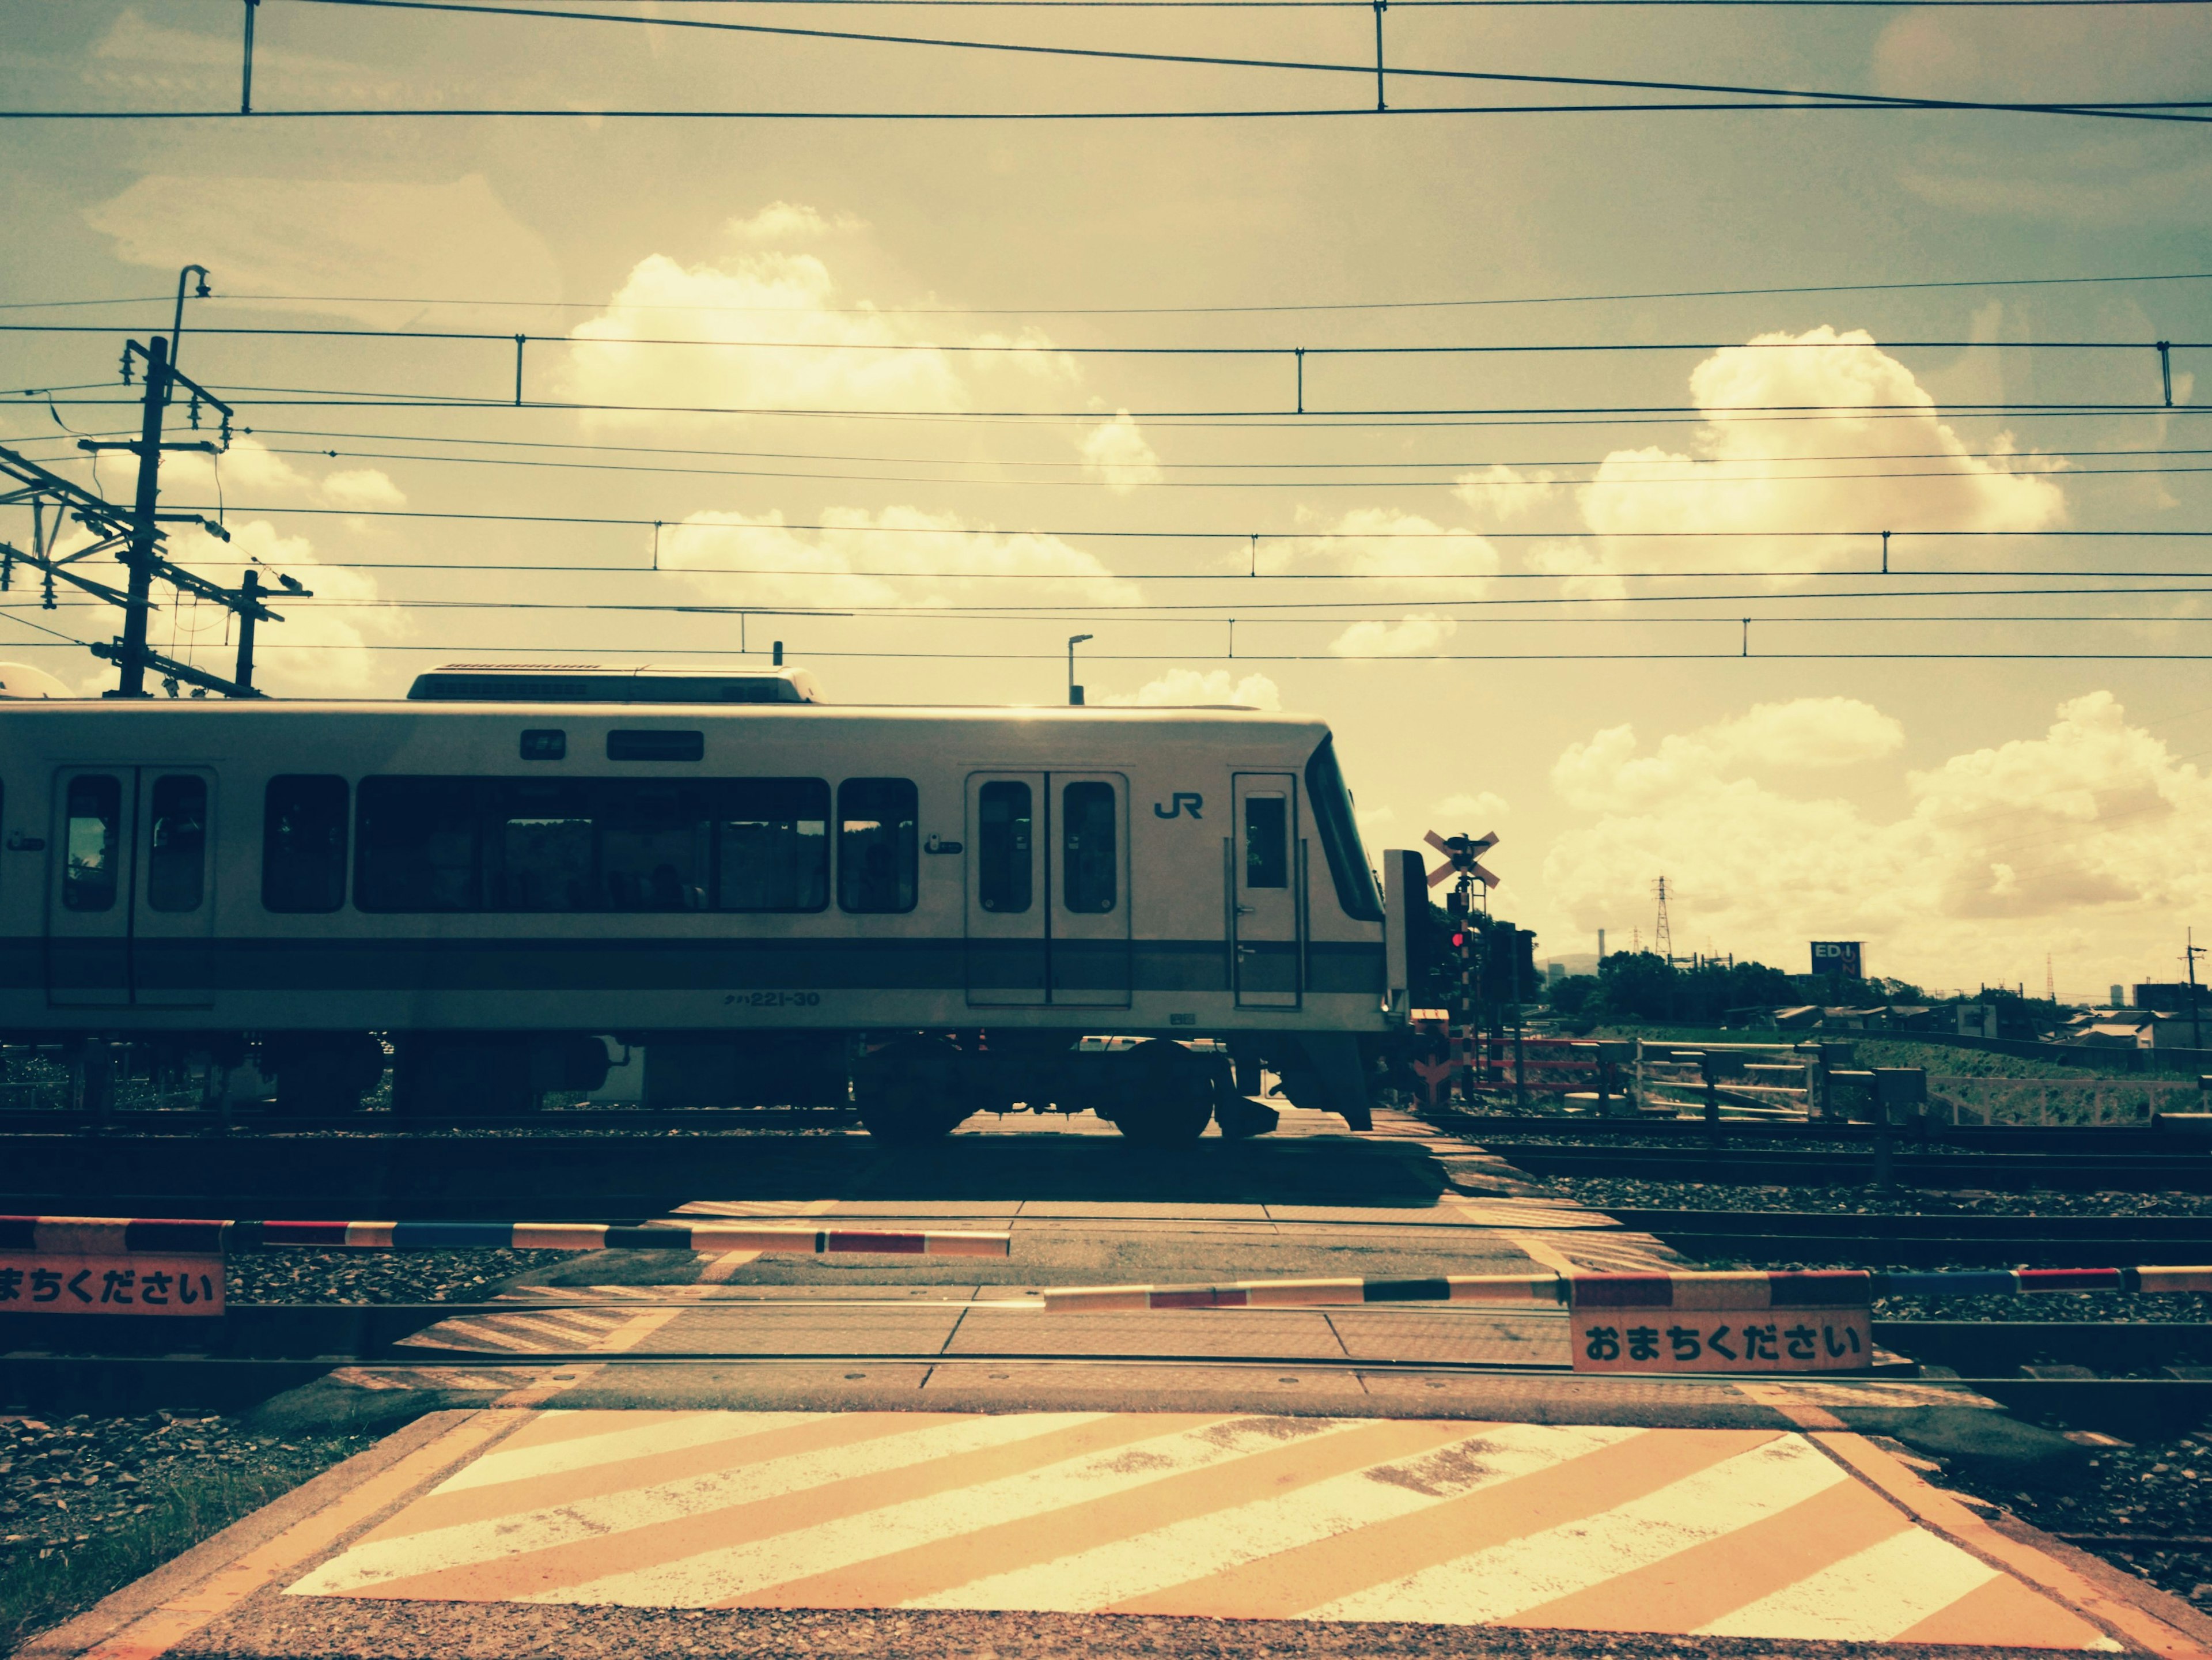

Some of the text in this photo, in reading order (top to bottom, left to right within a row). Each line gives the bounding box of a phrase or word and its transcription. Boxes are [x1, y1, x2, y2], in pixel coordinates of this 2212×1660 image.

[1154, 793, 1203, 819] JR
[0, 1268, 213, 1304] まちください
[1585, 1325, 1861, 1362] おまちください
